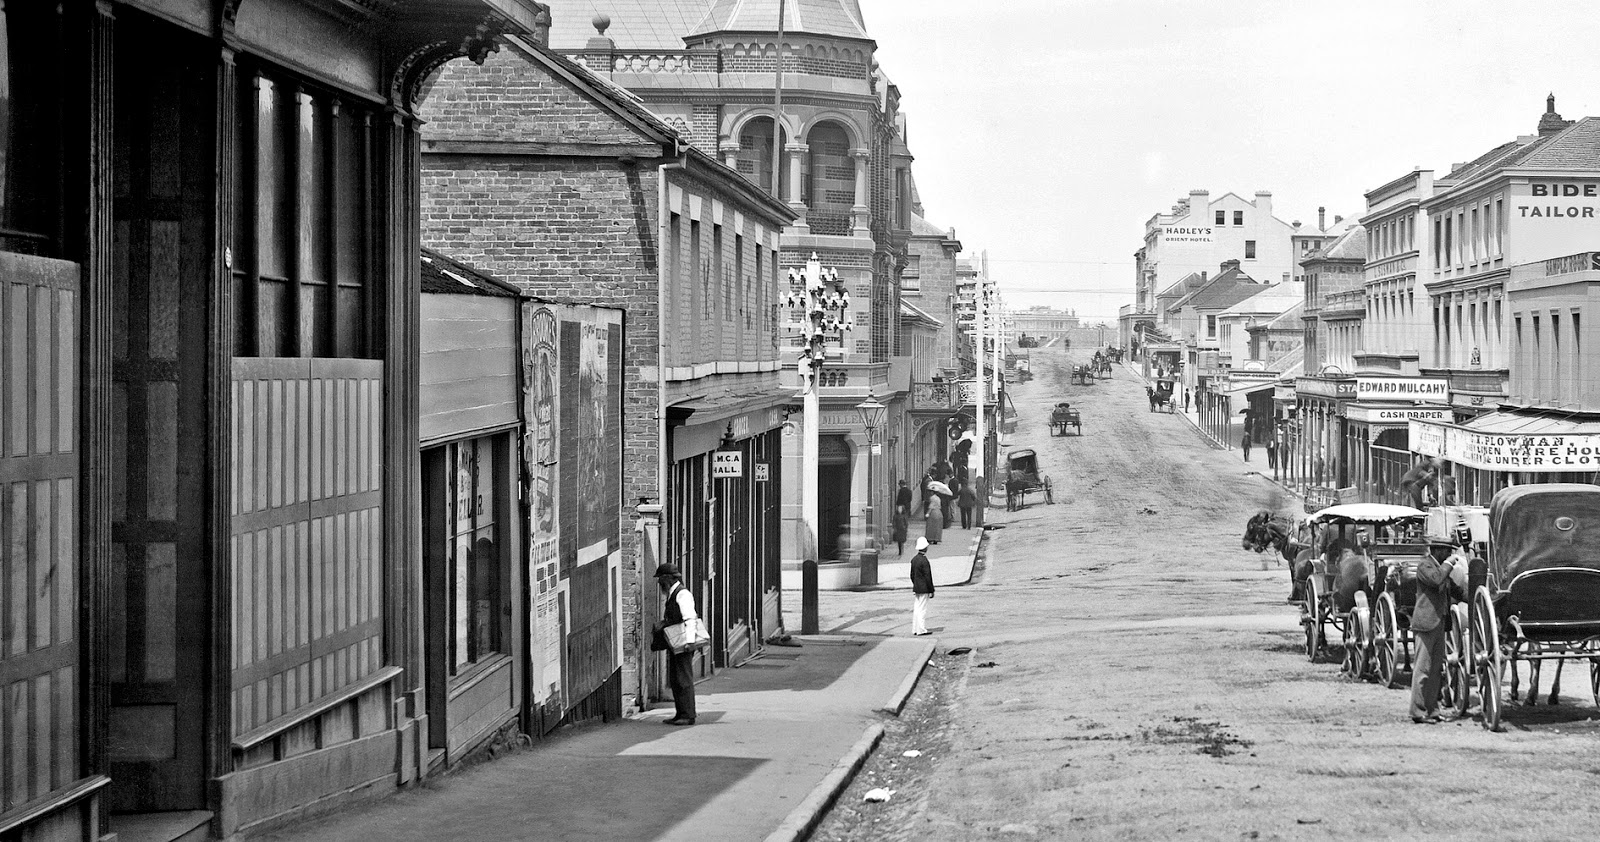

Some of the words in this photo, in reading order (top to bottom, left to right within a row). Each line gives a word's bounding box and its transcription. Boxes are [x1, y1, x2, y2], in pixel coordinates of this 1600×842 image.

[1532, 184, 1597, 197] BIDE
[1518, 206, 1594, 218] TAILOR
[1166, 227, 1212, 235] HADLEY'S
[1360, 382, 1397, 393] EDWARD
[1399, 383, 1446, 394] MULCAHY
[1380, 411, 1405, 419] CASH
